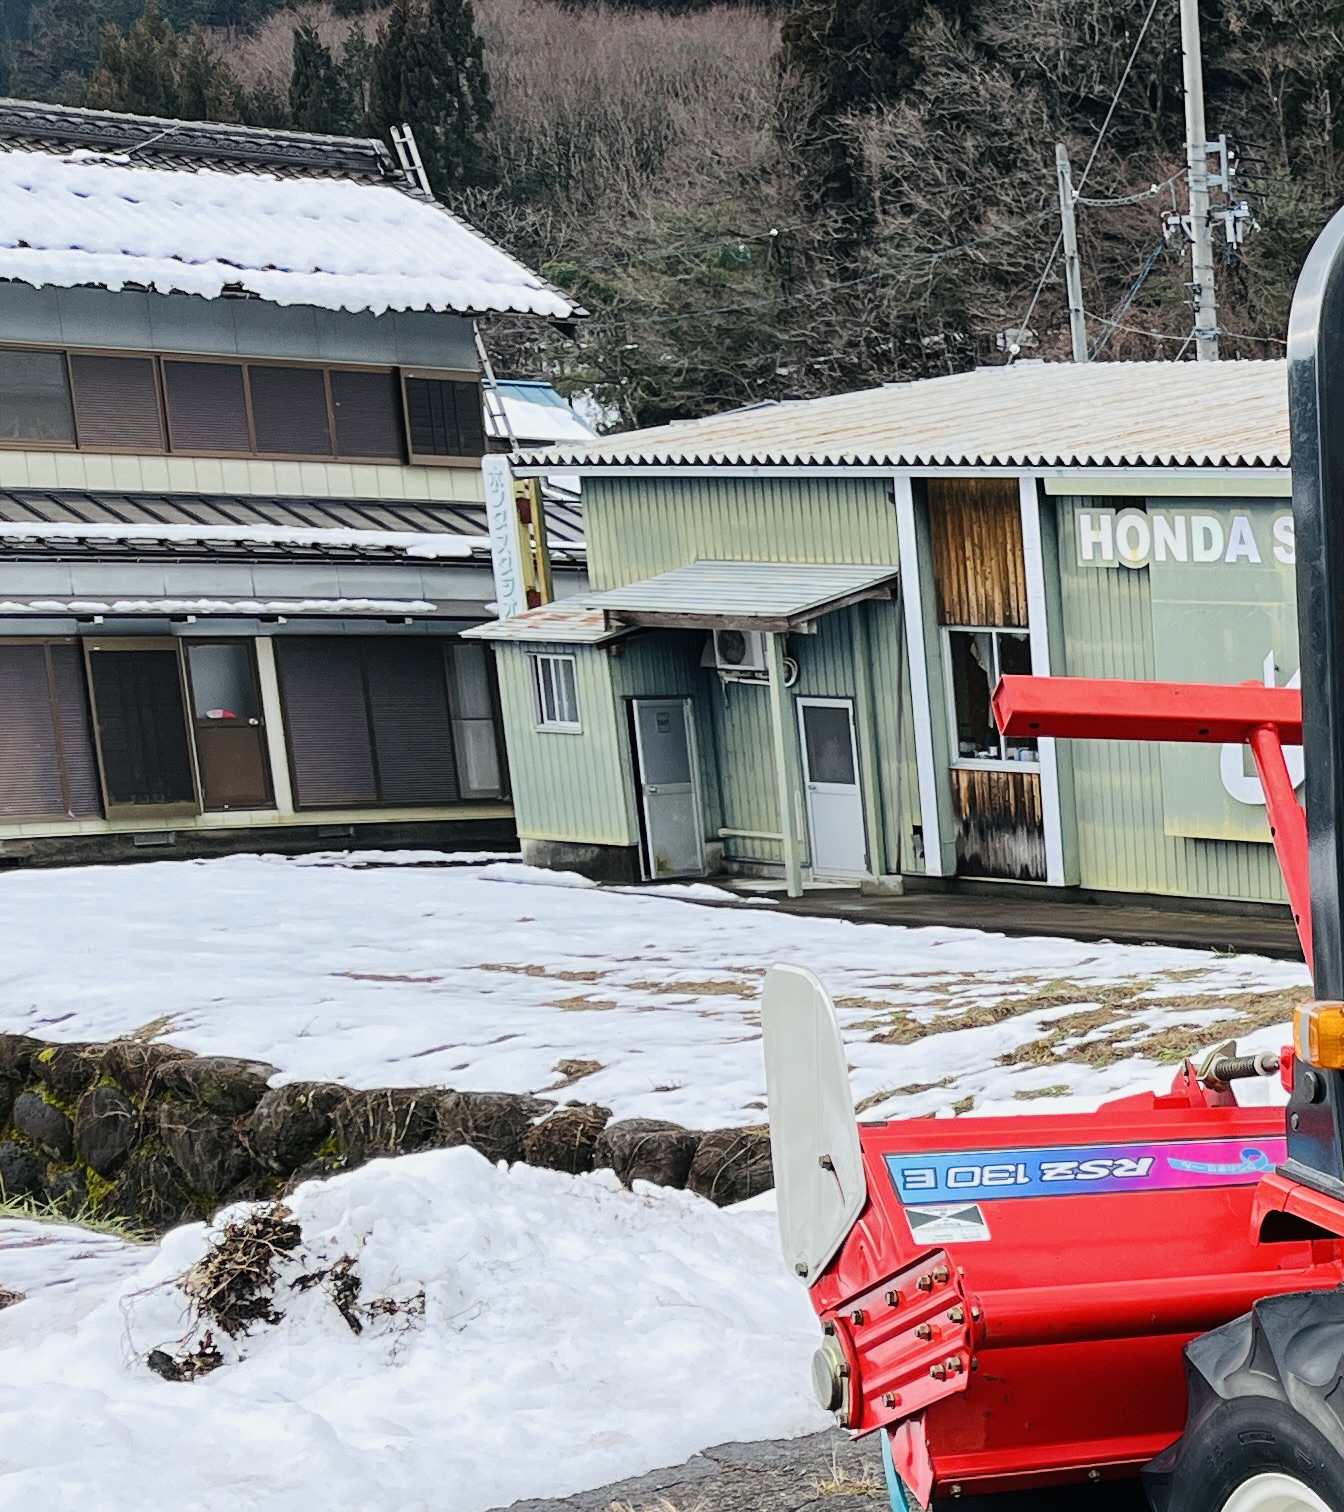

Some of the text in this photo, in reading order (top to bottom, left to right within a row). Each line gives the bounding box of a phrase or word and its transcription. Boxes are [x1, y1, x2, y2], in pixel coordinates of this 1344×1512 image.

[1078, 511, 1263, 566] HONDA
[901, 1166, 938, 1190] E
[946, 1162, 1031, 1188] 130
[1040, 1156, 1155, 1182] RSZ
